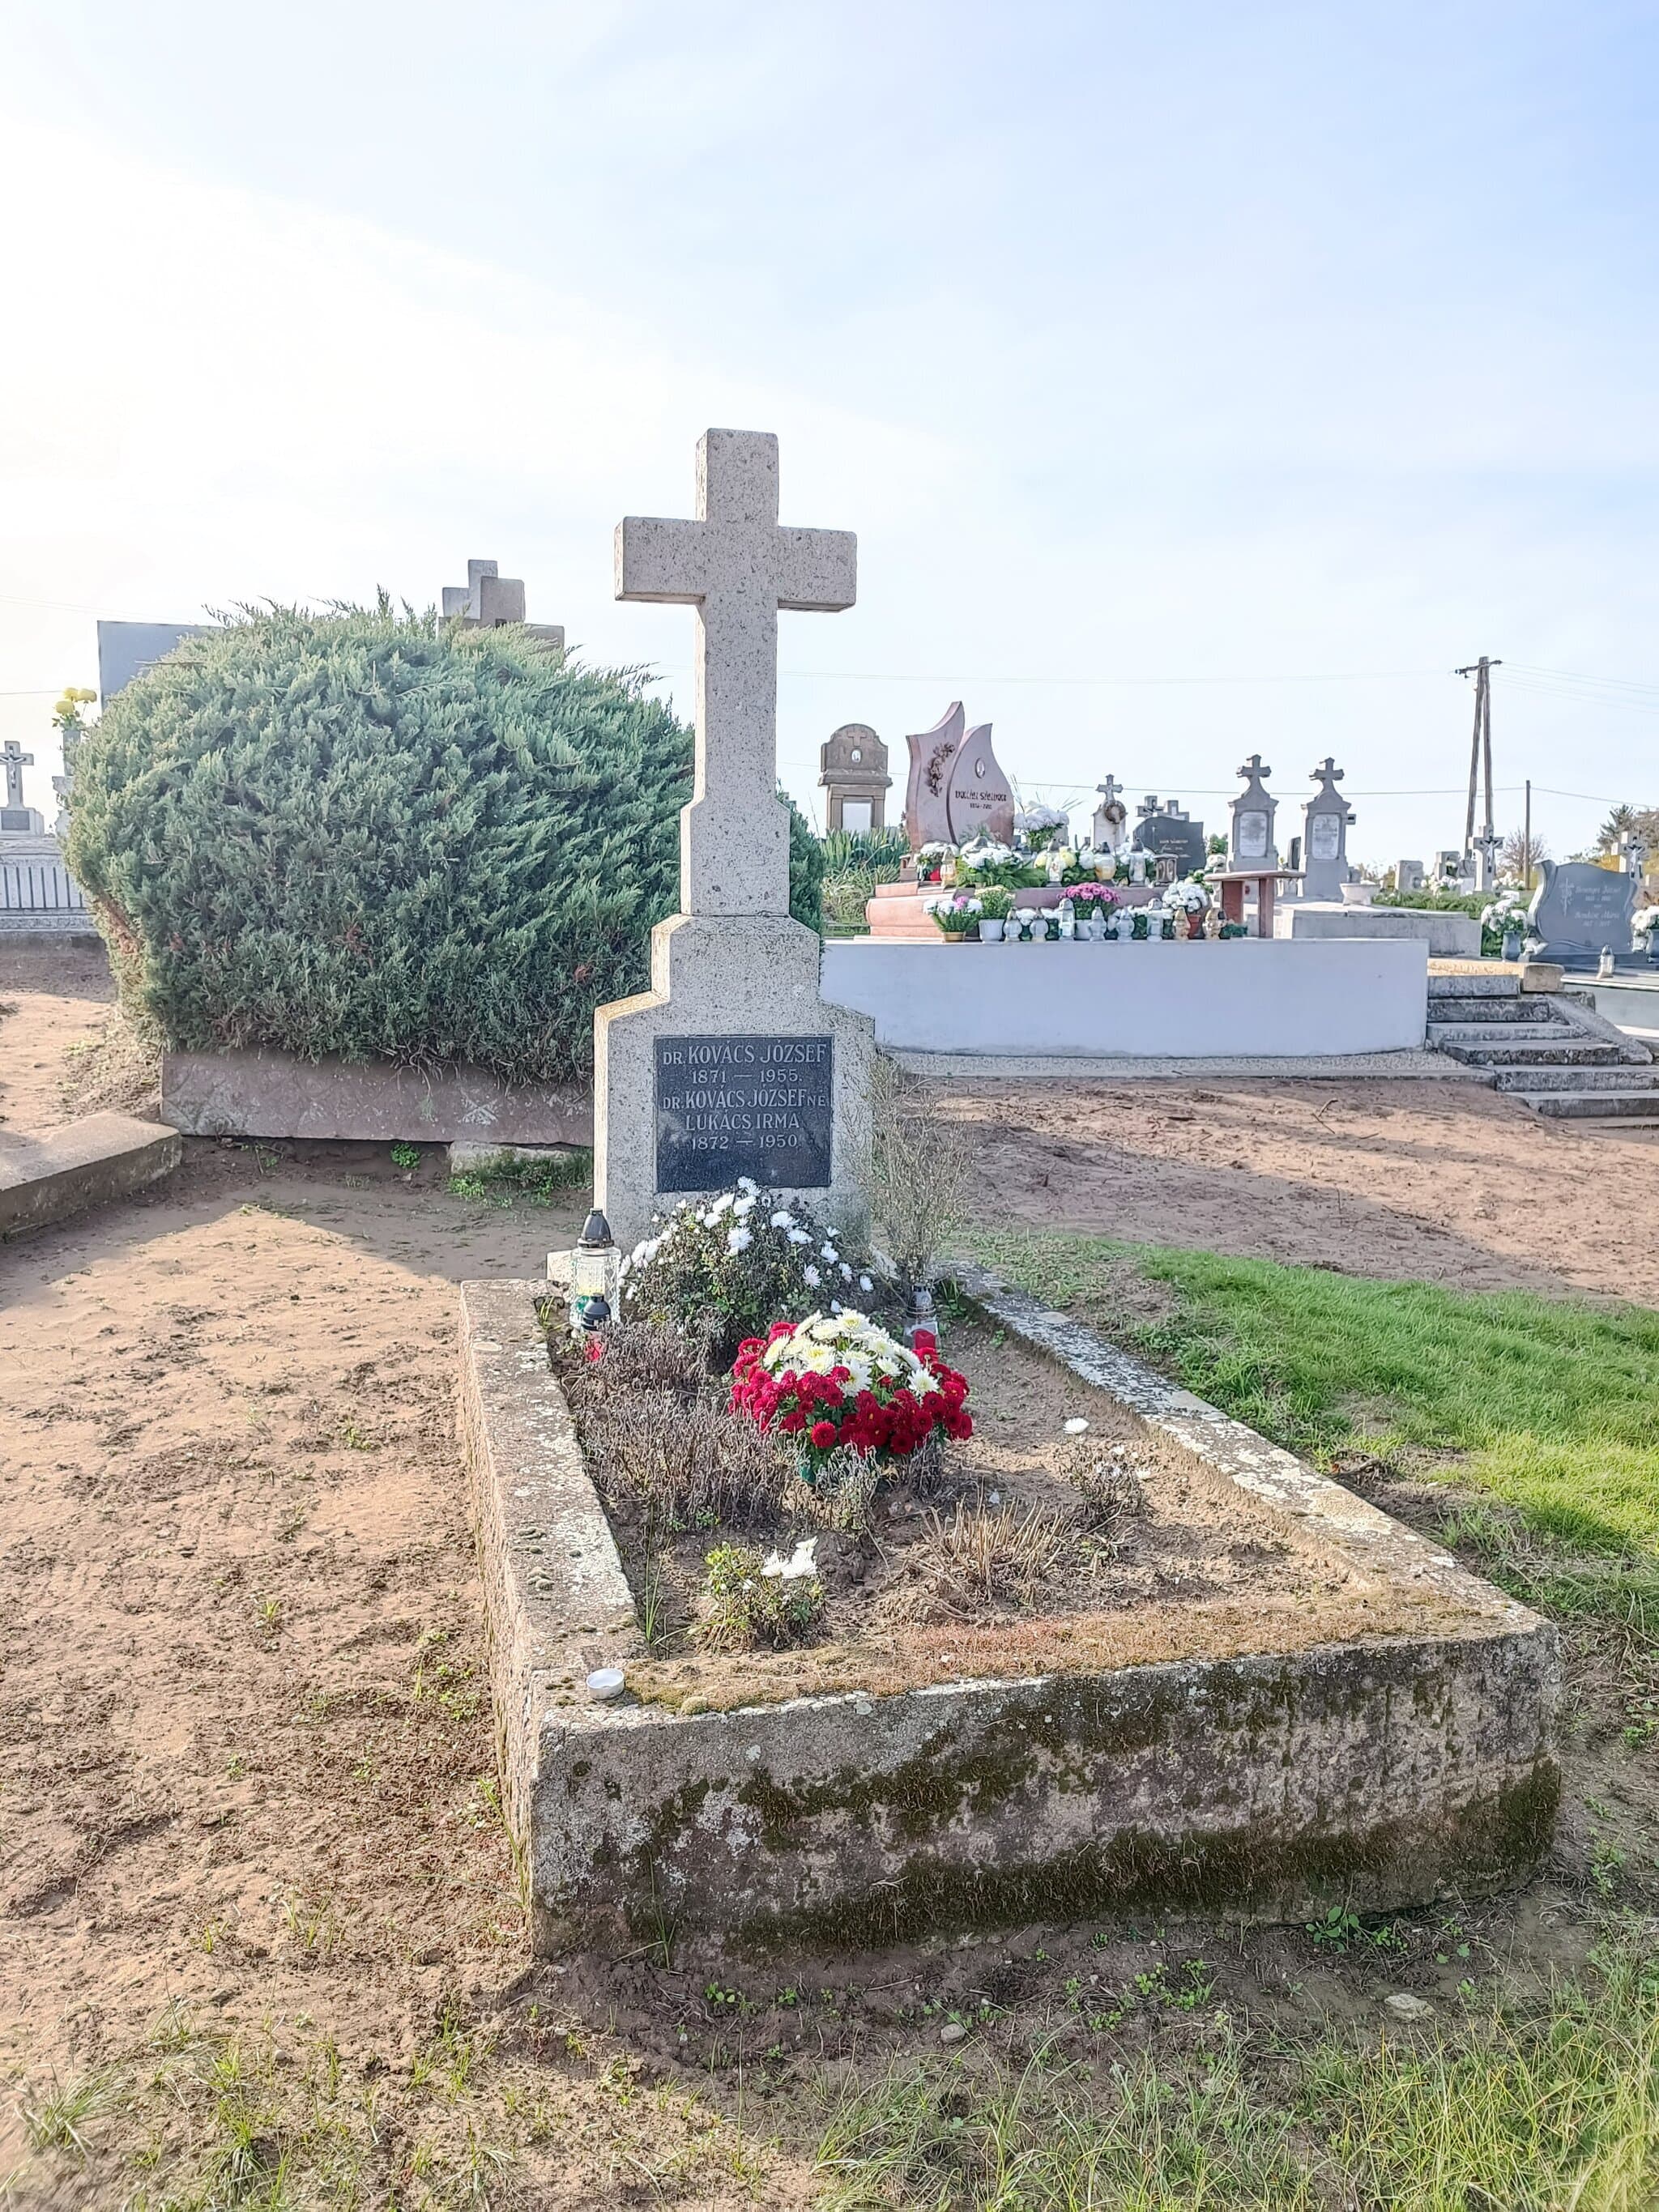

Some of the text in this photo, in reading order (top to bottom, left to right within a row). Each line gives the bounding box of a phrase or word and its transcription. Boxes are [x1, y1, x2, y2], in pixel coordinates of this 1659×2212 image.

[688, 1040, 755, 1064] KOVÁCS
[761, 1039, 827, 1063] JÓZSEF
[692, 1069, 727, 1084] 1871
[685, 1084, 745, 1109] KOVÁCS
[685, 1109, 800, 1131] LUKÁCS IRMA
[692, 1136, 729, 1150] 1872
